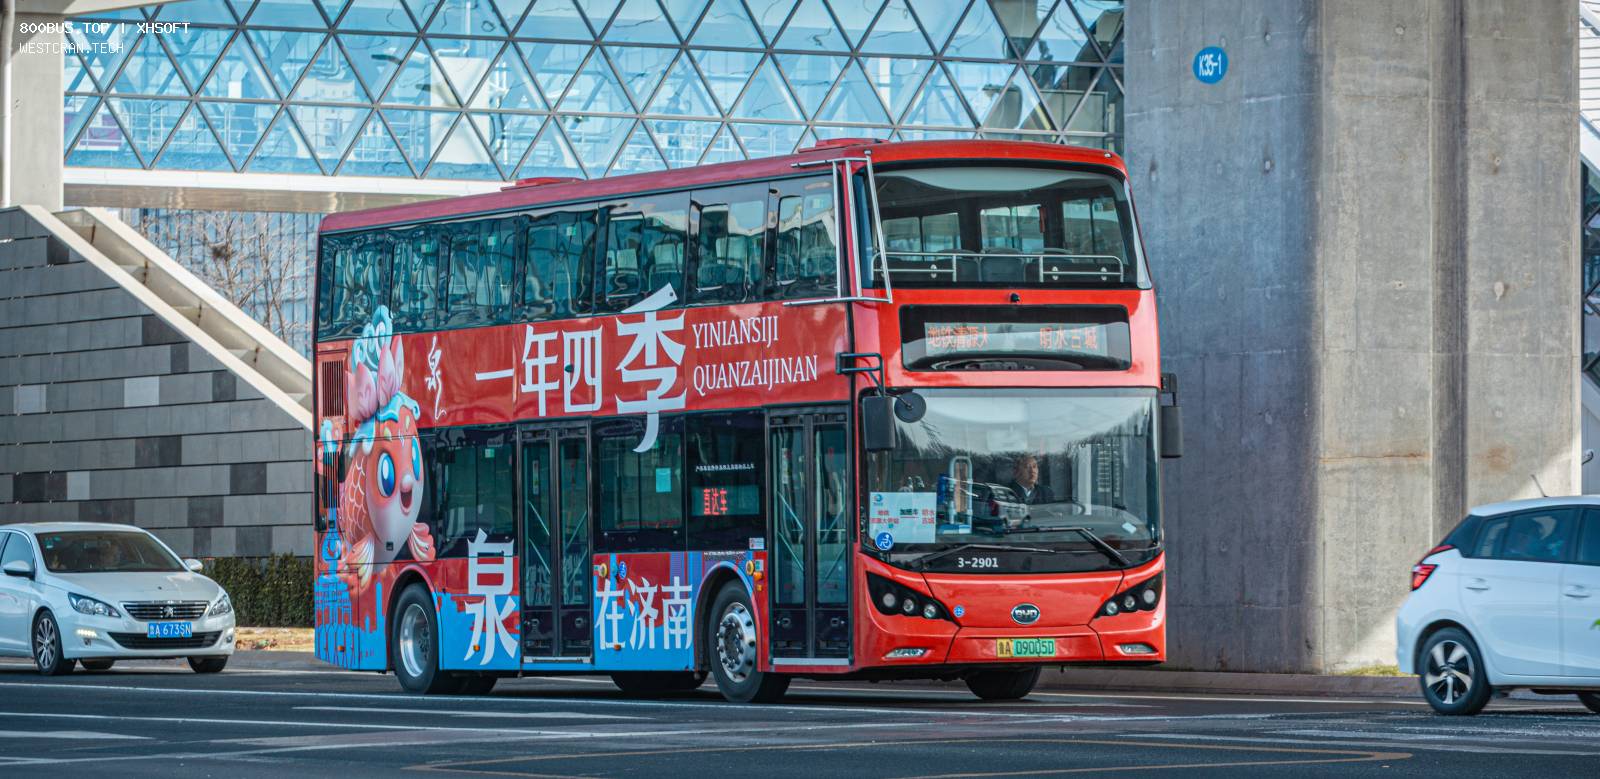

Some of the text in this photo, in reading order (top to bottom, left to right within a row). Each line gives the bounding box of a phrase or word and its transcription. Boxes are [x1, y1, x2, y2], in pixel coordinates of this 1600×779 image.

[1198, 53, 1222, 77] K35-1
[691, 316, 779, 350] YINIANSIJI
[475, 283, 687, 453] 一年四季
[693, 355, 818, 396] QUANZAIJINAN
[703, 487, 728, 516] 直达车
[957, 557, 999, 569] 3-2901
[464, 528, 693, 666] 泉 在济南
